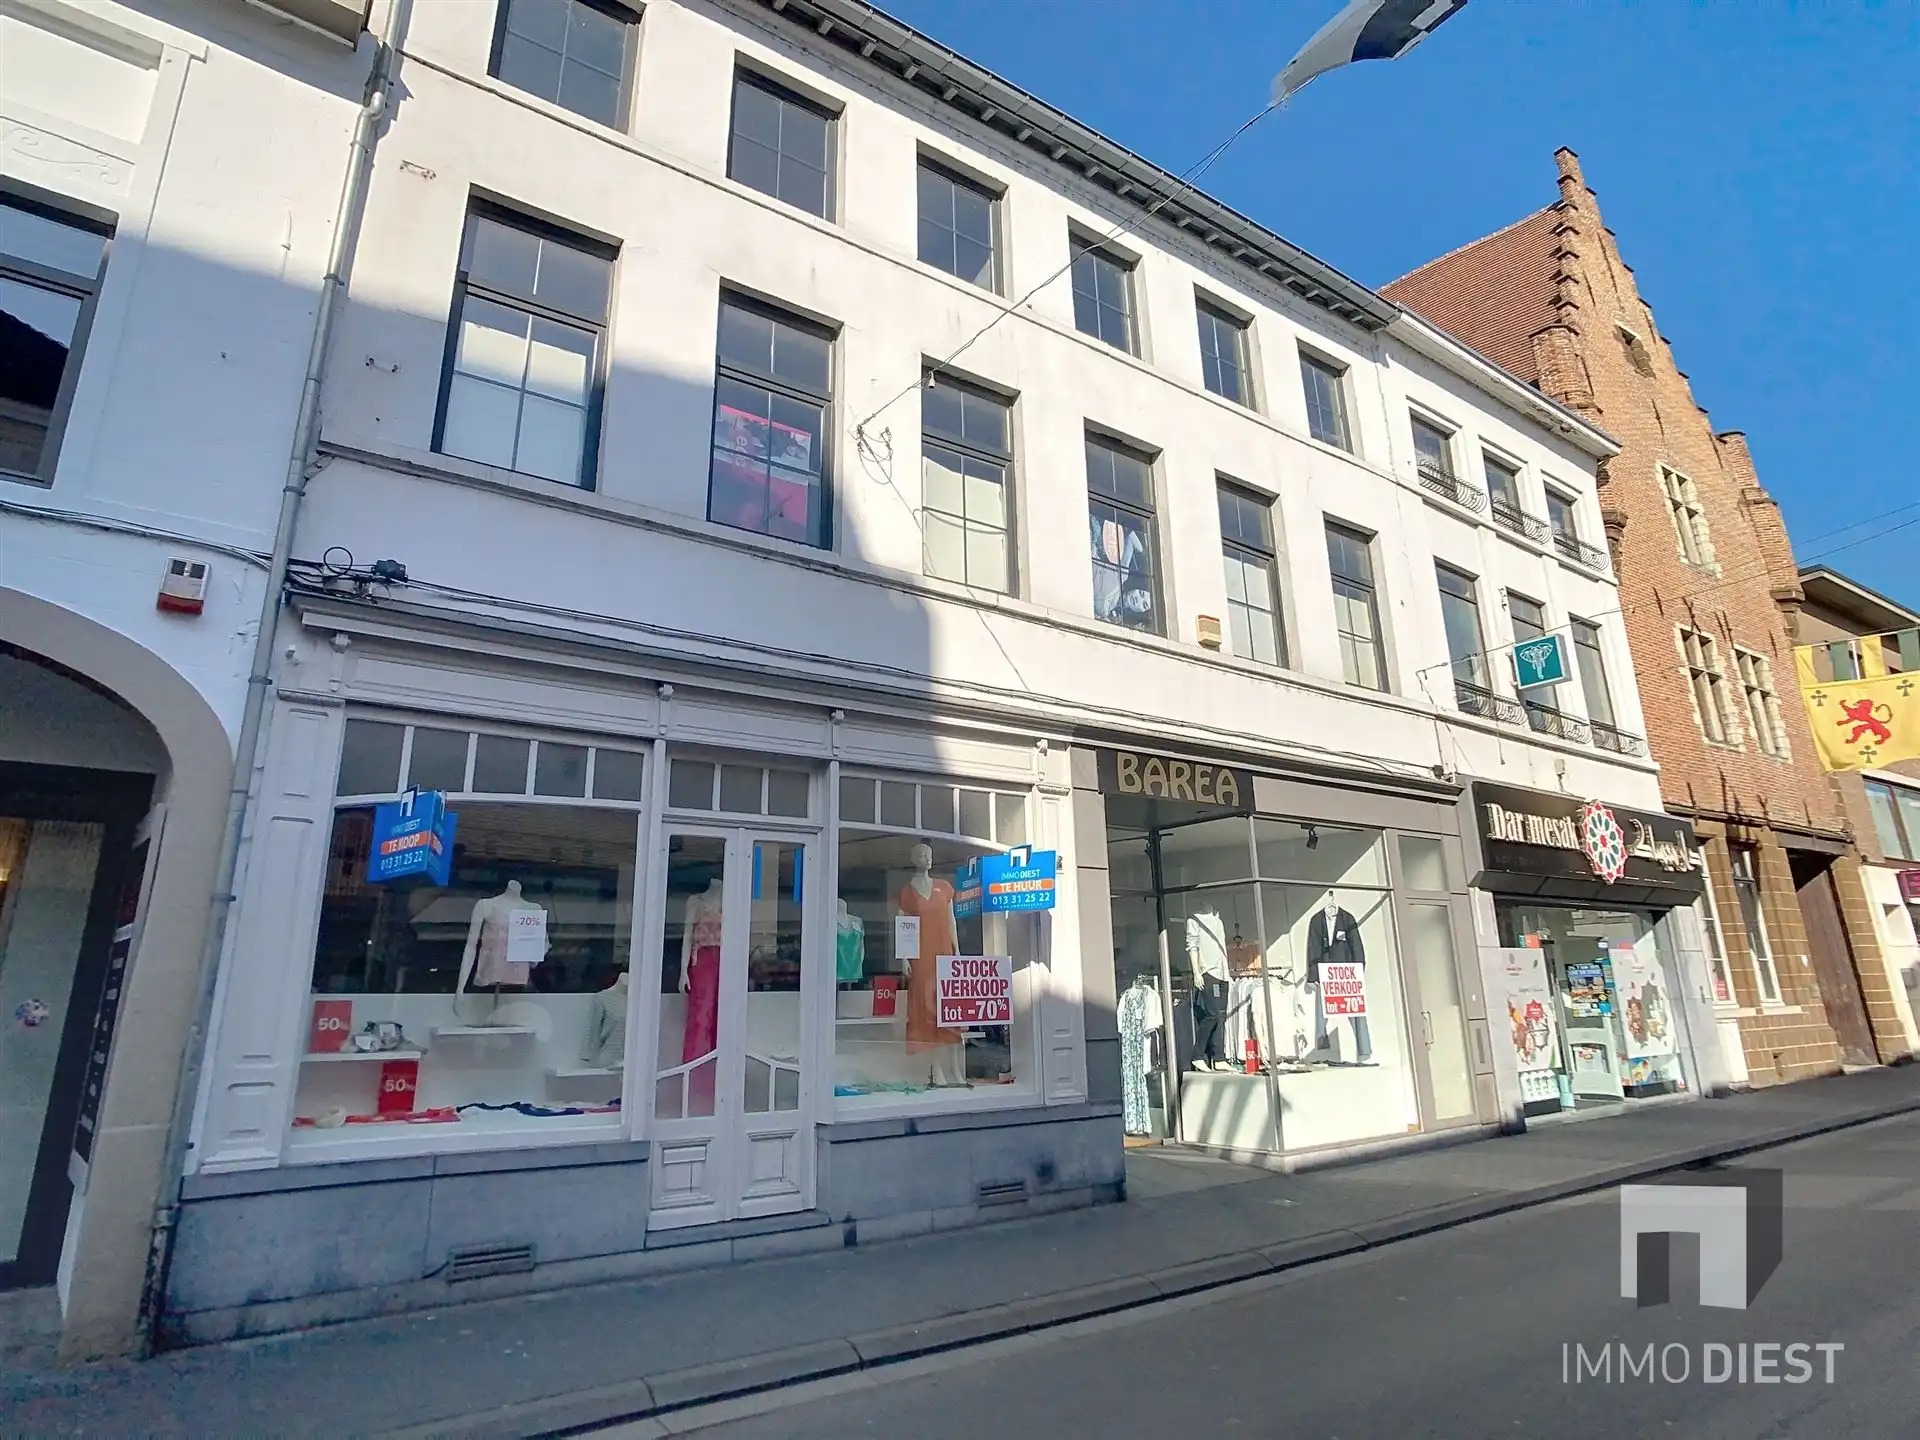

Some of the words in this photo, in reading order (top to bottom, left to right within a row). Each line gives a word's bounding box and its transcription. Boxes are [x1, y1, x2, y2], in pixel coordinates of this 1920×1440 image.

[1117, 752, 1239, 806] BAREA
[1481, 803, 1525, 843] Dar
[388, 839, 397, 852] TE
[398, 834, 420, 850] KOOP
[381, 857, 394, 870] 013
[394, 855, 402, 867] 31
[403, 852, 413, 865] 25
[414, 850, 424, 862] 22
[1001, 871, 1020, 881] IMMO
[1020, 869, 1041, 879] DIEST
[1000, 883, 1013, 893] TE
[1013, 880, 1042, 892] HUUR
[992, 895, 1008, 905] 013
[1011, 895, 1021, 904] 31
[1025, 893, 1036, 903] 25
[1039, 892, 1050, 902] 22
[951, 960, 999, 978] STOCK
[1327, 966, 1357, 980] STOCK
[940, 979, 1009, 997] VERKOOP
[1322, 981, 1363, 995] VERKOOP
[944, 1005, 963, 1021] tot
[968, 999, 1007, 1020] -70%
[1326, 1002, 1339, 1013] tot
